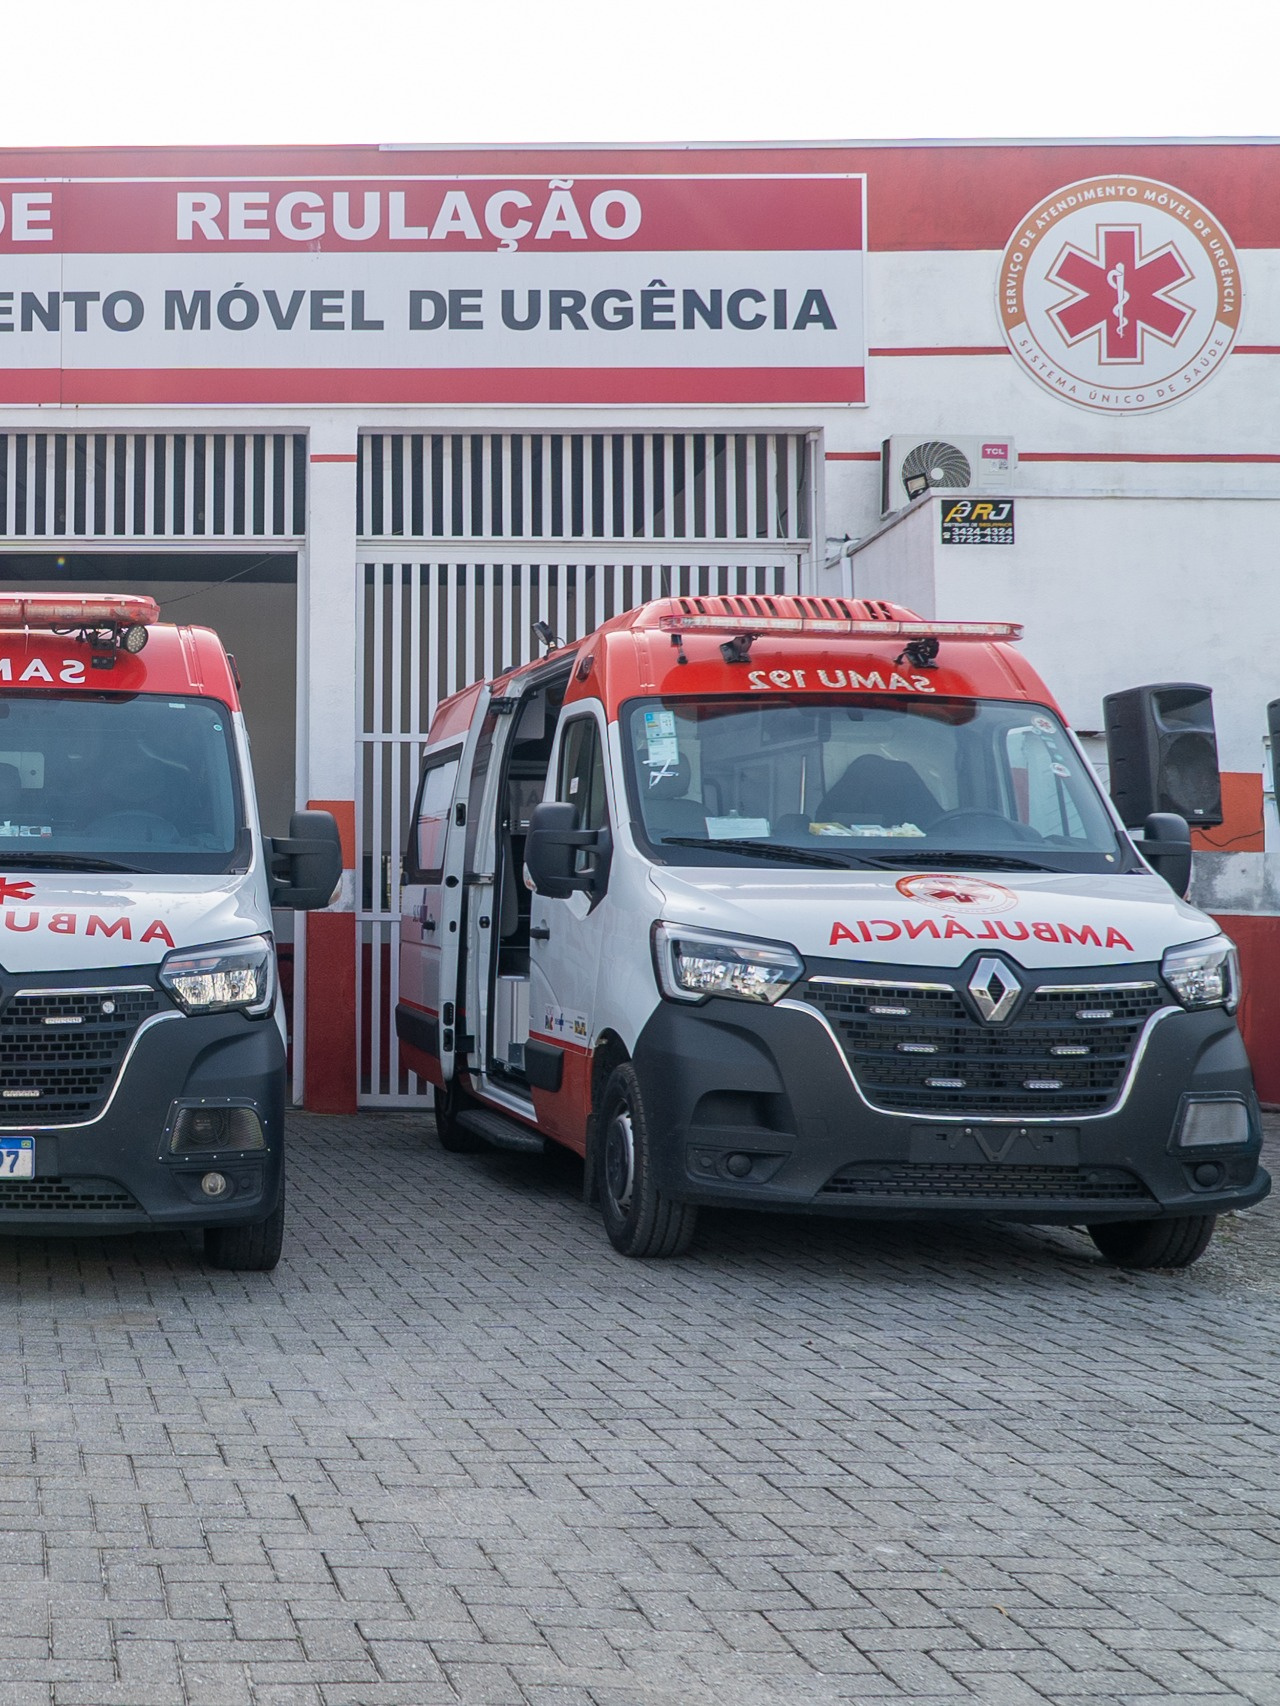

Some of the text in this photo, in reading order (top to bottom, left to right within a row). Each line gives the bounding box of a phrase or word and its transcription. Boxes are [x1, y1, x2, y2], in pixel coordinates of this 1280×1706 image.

[176, 178, 643, 253] REGULAÇÃO
[1007, 185, 1235, 314] SERVIÇO DE ATENDIMENTO MÓVEL DE URGÊNCIA
[163, 281, 384, 332] MÓVEL
[408, 289, 483, 331] DE
[500, 279, 838, 332] URGÊNCIA
[1019, 338, 1224, 405] SISTEMA ÚNICO DE SAÚDE
